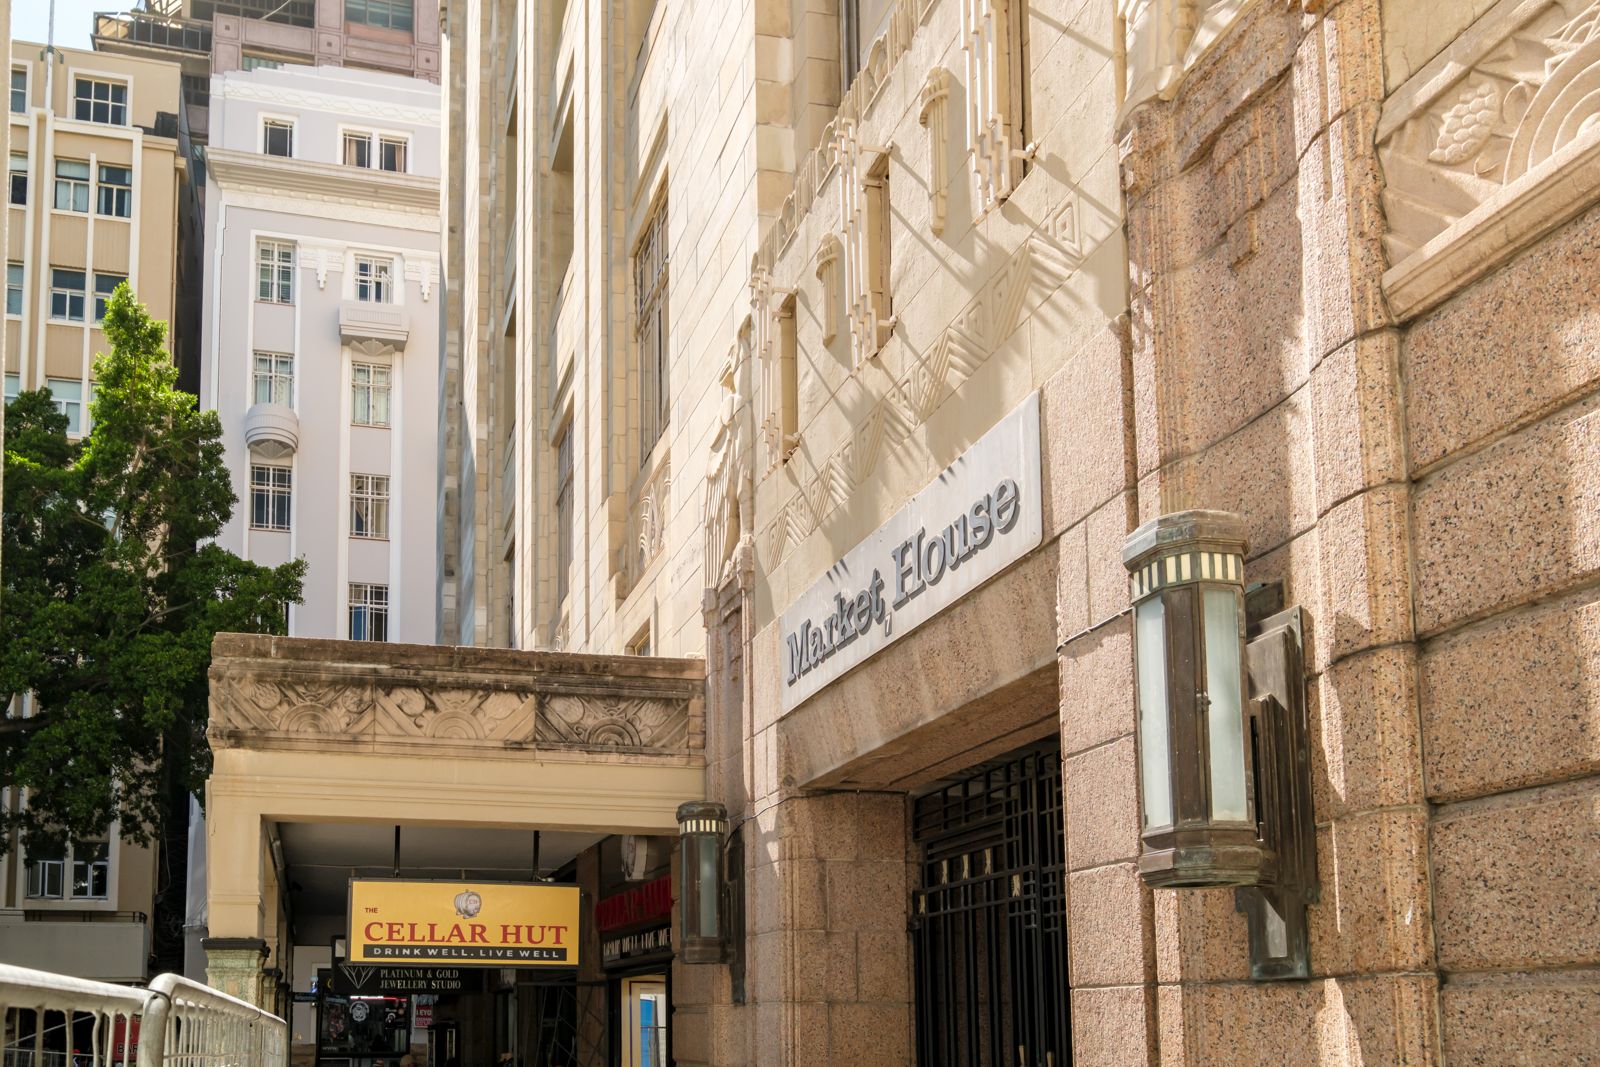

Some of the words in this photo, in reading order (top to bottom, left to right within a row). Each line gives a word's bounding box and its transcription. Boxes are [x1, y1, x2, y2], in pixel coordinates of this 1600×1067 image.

[786, 568, 885, 687] Market
[891, 478, 1020, 611] House
[364, 922, 490, 943] CELLAR
[500, 924, 568, 945] HUT
[373, 947, 421, 956] DRINK
[427, 948, 475, 956] WELL.
[479, 949, 513, 957] LIVE
[519, 950, 559, 958] WELL
[380, 968, 423, 978] PLATINUM
[426, 969, 432, 978] &
[436, 969, 459, 978] GOLD
[380, 979, 427, 989] JEWELLERY
[431, 979, 461, 989] STUDIO
